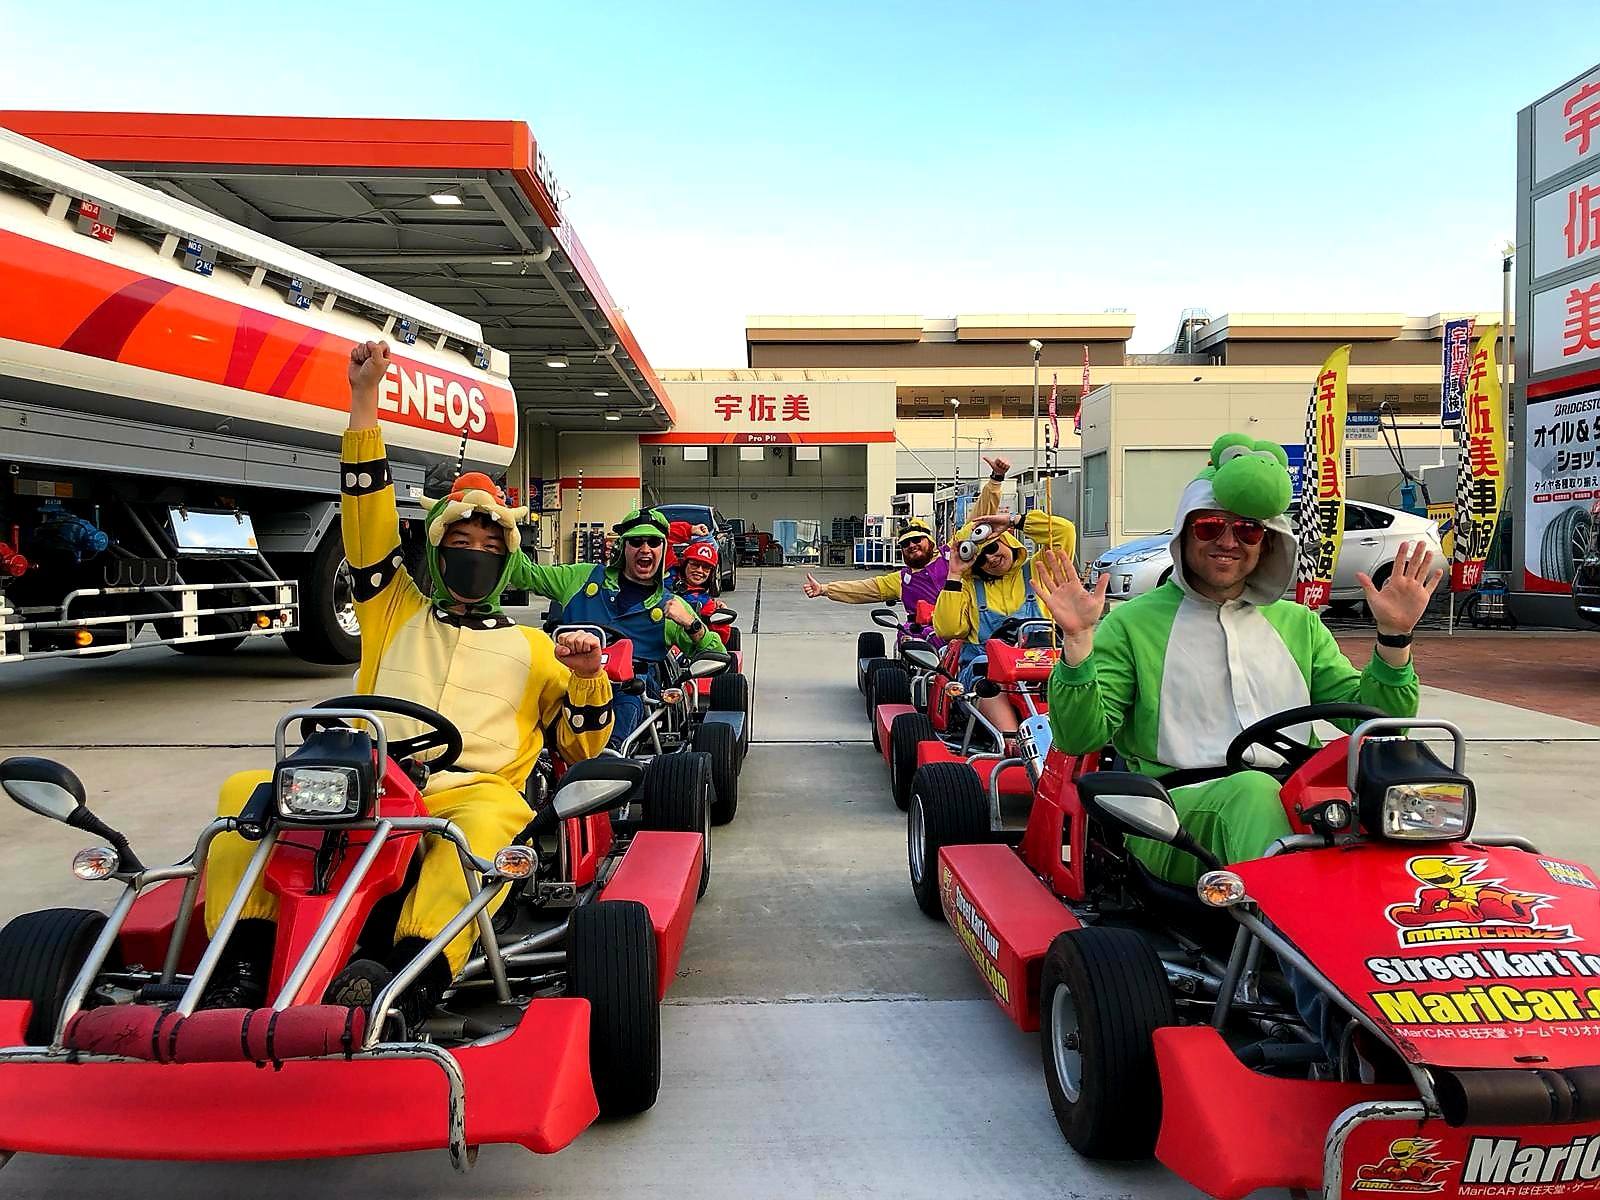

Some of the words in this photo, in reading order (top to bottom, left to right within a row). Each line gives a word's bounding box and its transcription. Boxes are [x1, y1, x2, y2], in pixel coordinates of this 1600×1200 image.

[378, 363, 486, 433] ENEOS
[714, 394, 810, 421] 宇佐美
[765, 434, 777, 442] Pit
[1367, 953, 1490, 984] Street
[1483, 949, 1571, 979] Kart
[1399, 1028, 1456, 1039] MariCAR
[1457, 1186, 1516, 1196] MariCAR
